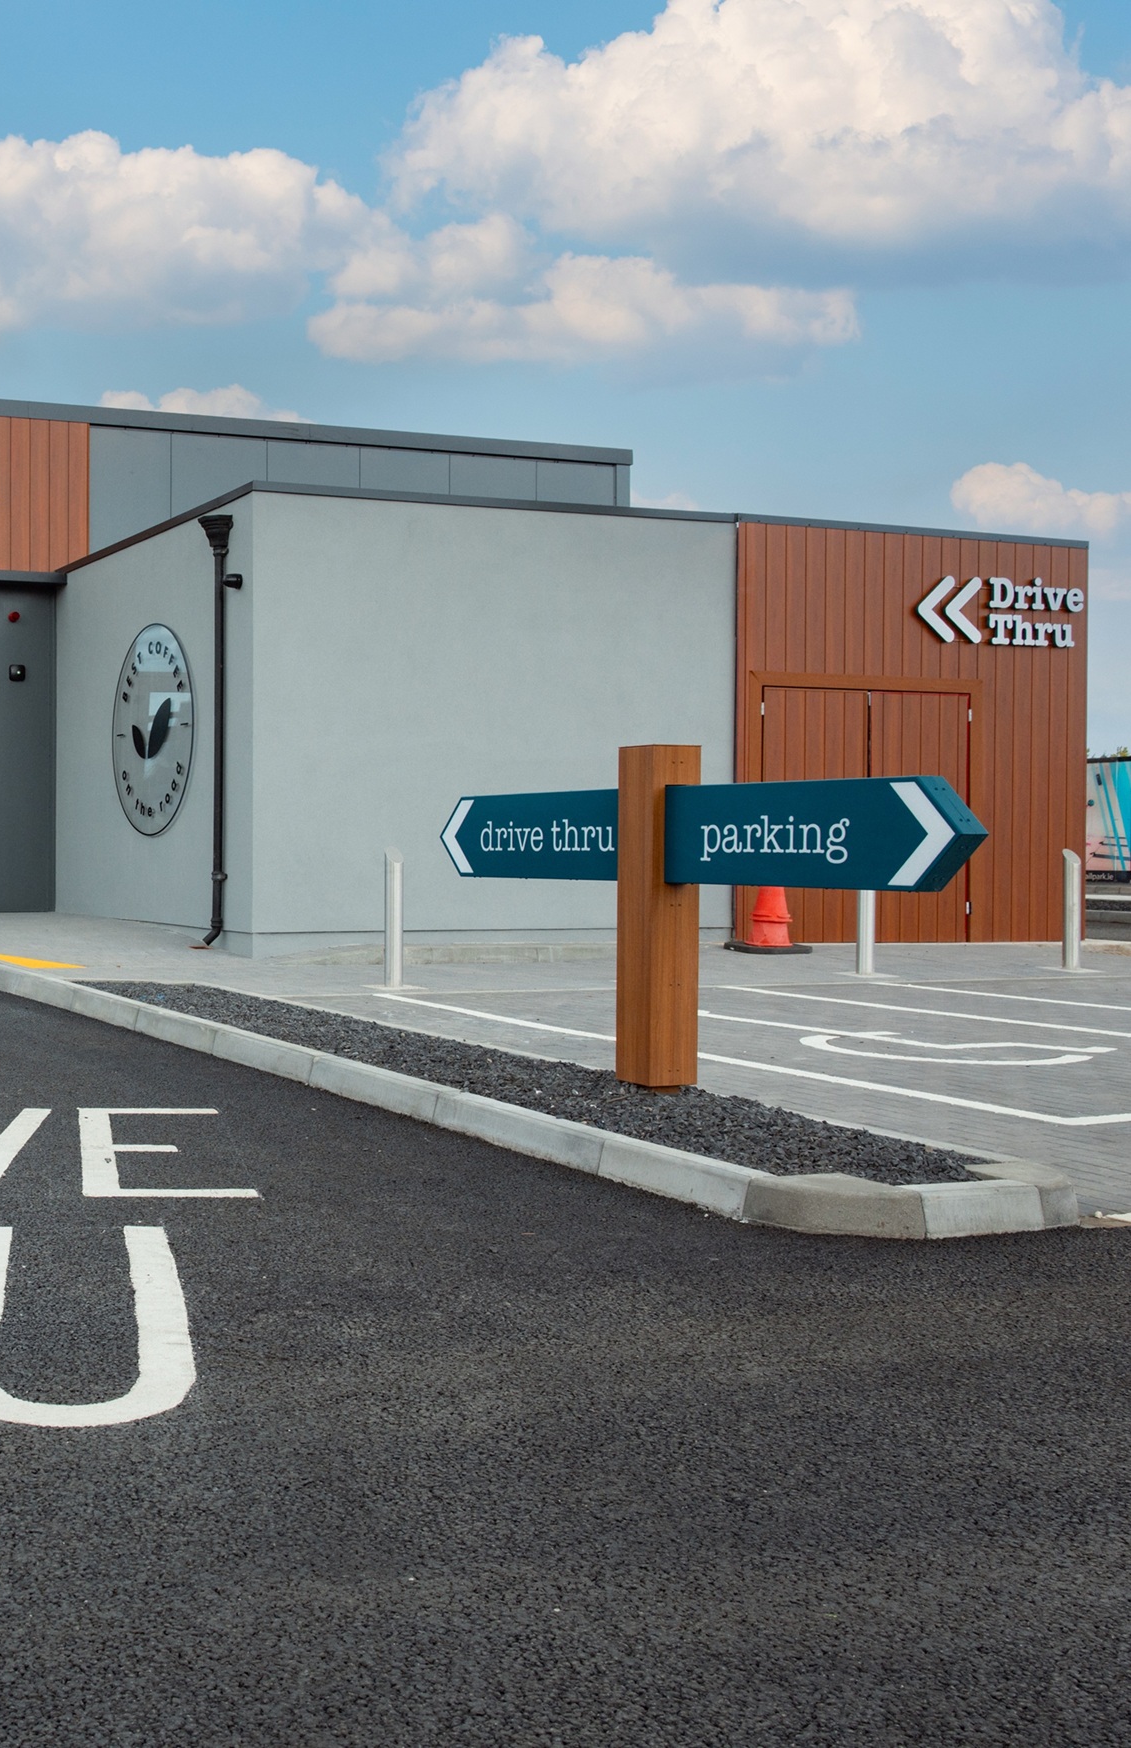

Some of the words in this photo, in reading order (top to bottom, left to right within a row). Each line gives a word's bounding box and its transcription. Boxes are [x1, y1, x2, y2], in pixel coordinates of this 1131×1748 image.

[989, 577, 1085, 613] Drive
[989, 613, 1075, 648] Thru
[122, 652, 141, 703] BEST
[148, 641, 184, 692] COFFEE
[122, 770, 132, 796] on
[134, 798, 153, 817] the
[159, 761, 182, 812] road
[479, 819, 545, 854] drive
[551, 818, 616, 853] thru
[699, 815, 851, 864] parking
